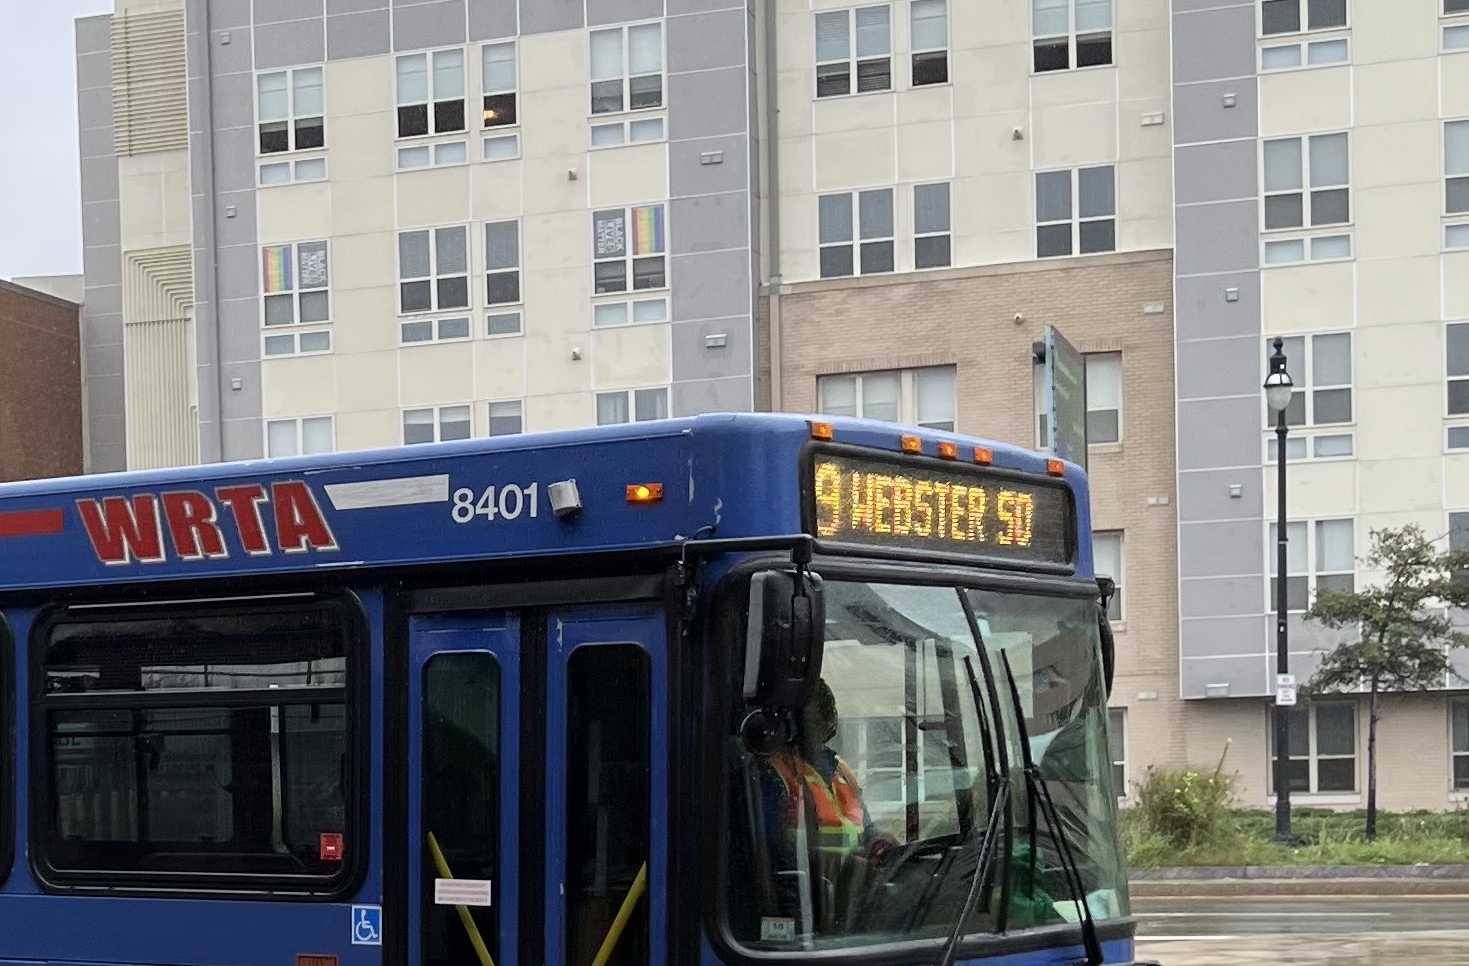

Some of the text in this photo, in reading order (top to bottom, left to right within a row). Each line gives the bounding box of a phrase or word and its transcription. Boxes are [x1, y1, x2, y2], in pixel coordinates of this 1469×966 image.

[596, 219, 605, 254] MATTER
[605, 219, 615, 253] LIVES
[614, 217, 624, 251] BLACK
[452, 483, 539, 524] 8401
[814, 462, 841, 536] 9
[851, 471, 986, 542] WEBSTER
[75, 480, 340, 566] WRTA
